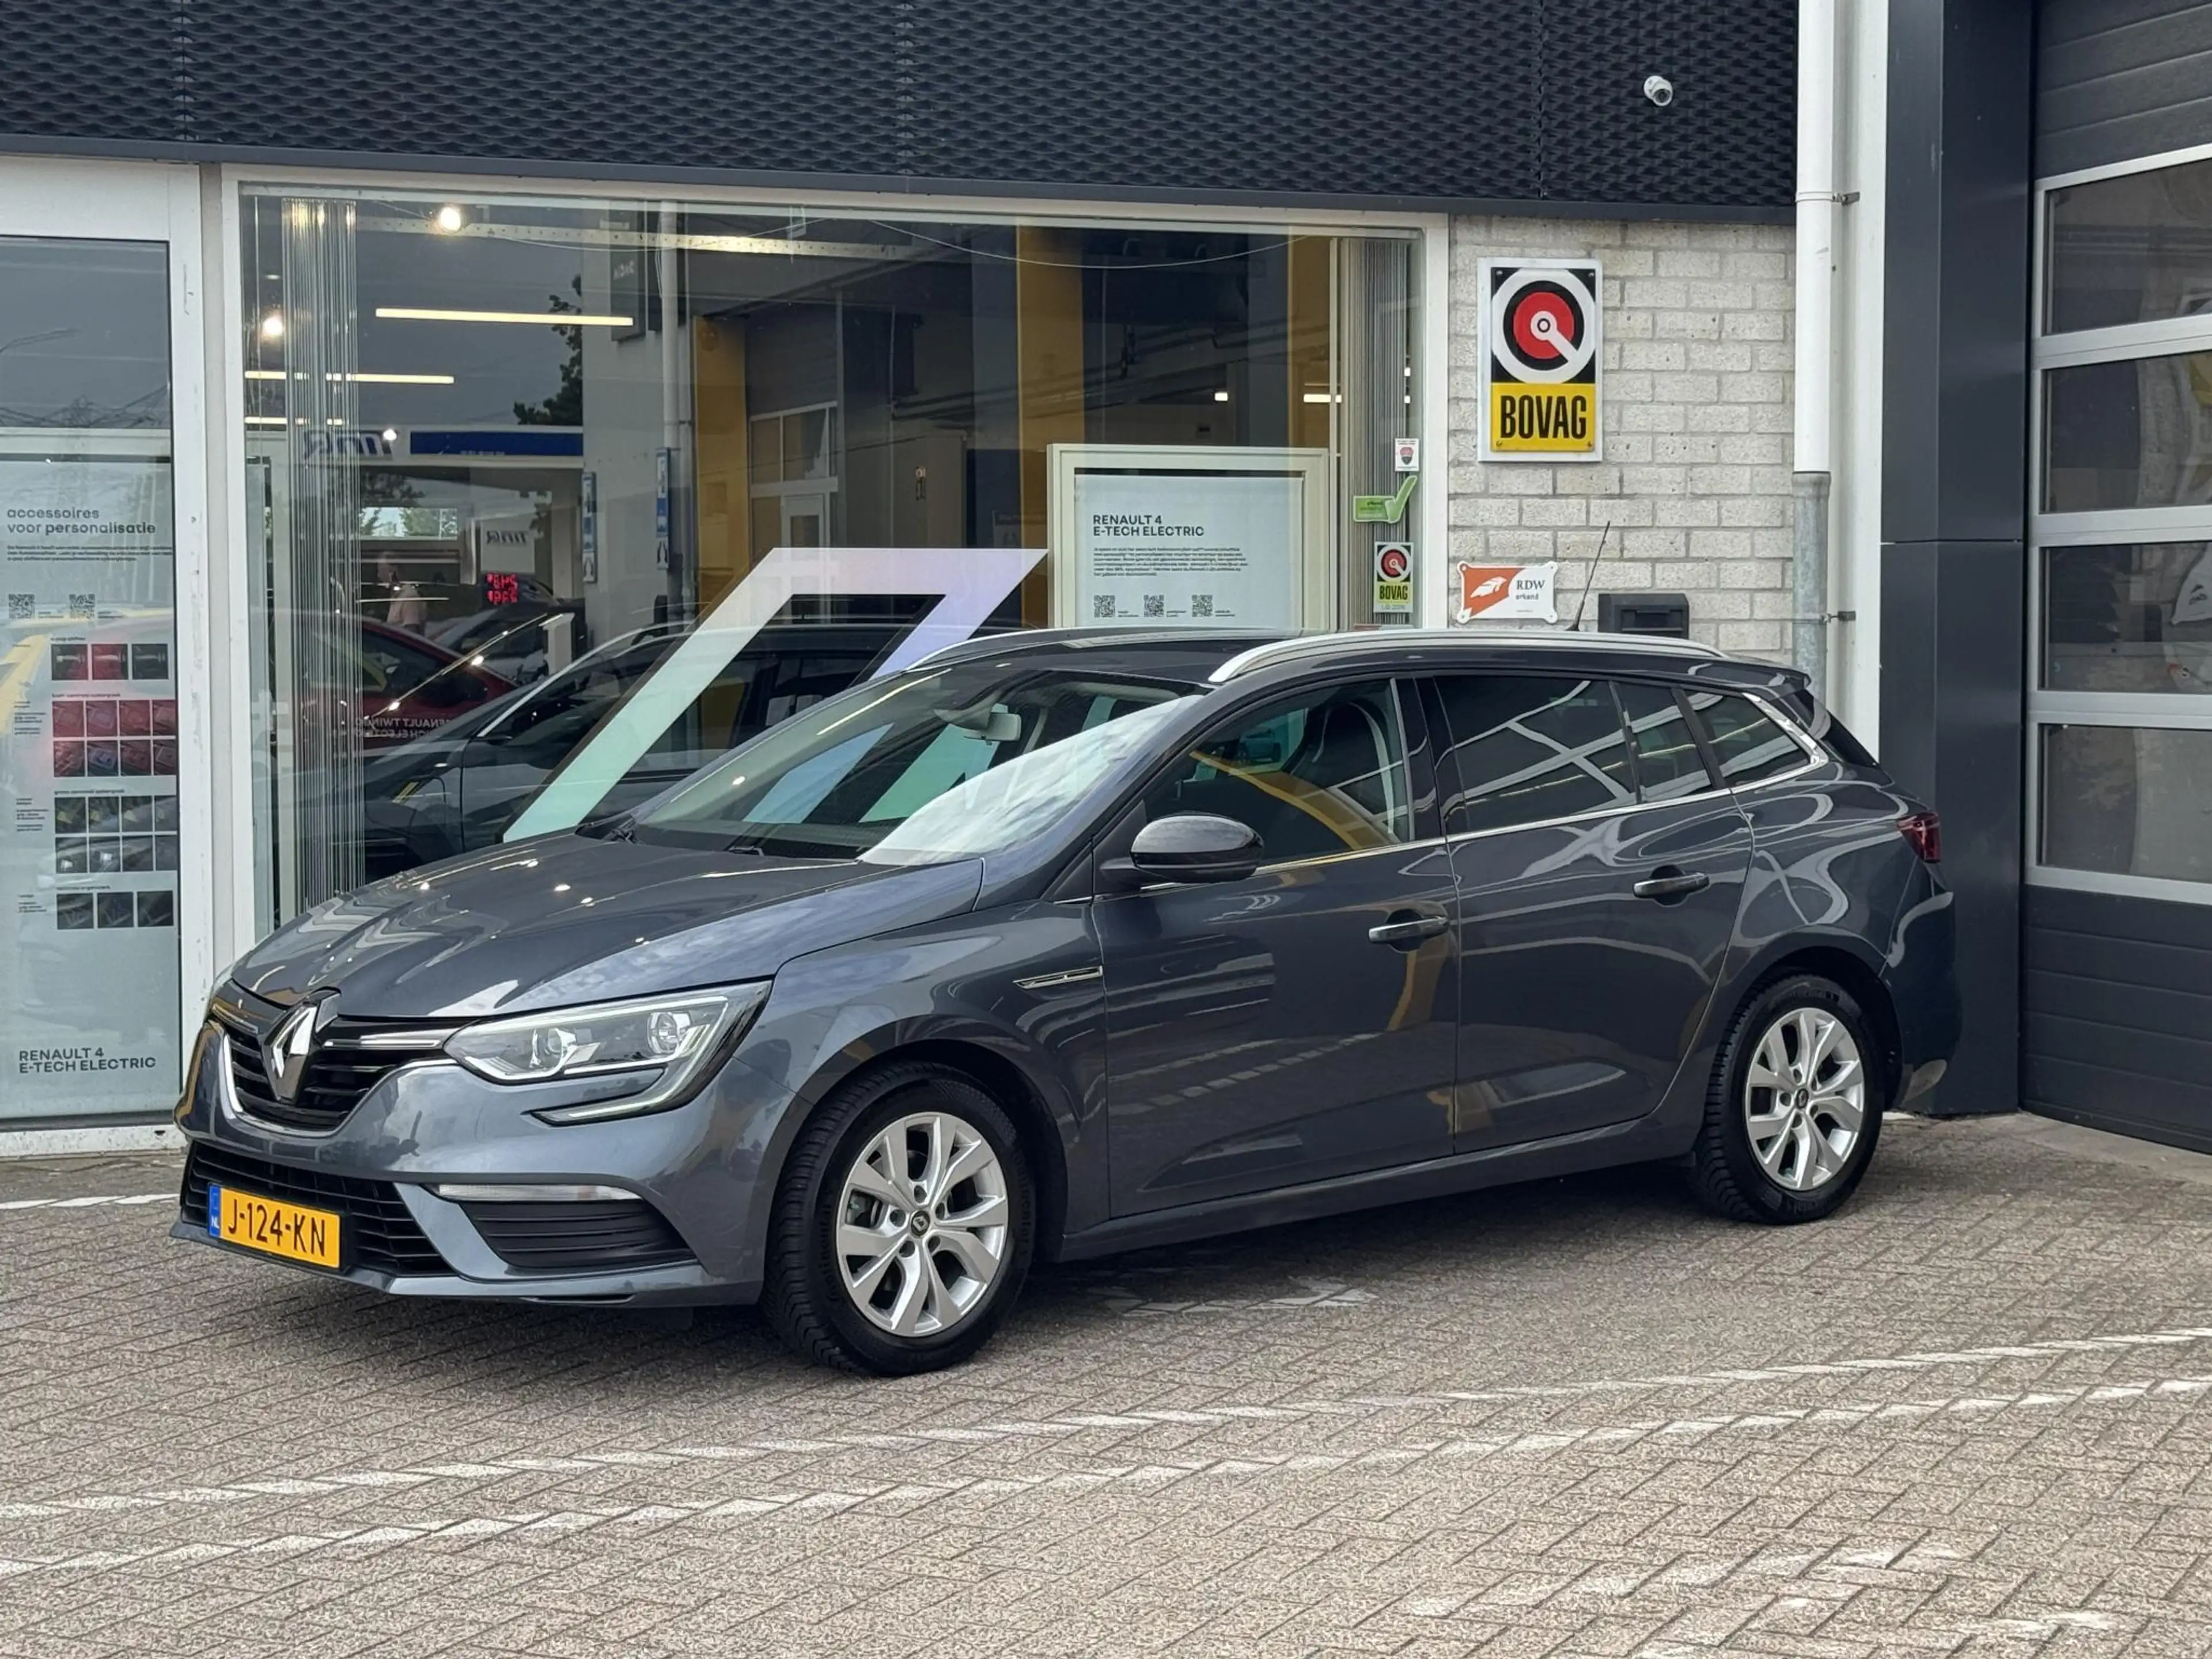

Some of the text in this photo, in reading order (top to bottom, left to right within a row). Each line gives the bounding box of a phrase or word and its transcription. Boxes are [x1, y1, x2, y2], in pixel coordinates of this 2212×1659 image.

[1500, 395, 1587, 440] BOVAG
[7, 507, 100, 519] accessoires
[1093, 514, 1162, 525] RENAULT 4
[7, 521, 157, 536] voor personalisatie
[1093, 526, 1205, 536] E-TECH ELECTRIC
[1516, 579, 1546, 590] RDW
[1379, 585, 1408, 600] BOVAG
[19, 1047, 104, 1061] RENAULT 4
[20, 1057, 156, 1074] E-TECH ELECTRIC
[211, 1215, 220, 1229] NL
[228, 1199, 325, 1257] J-124-KN
